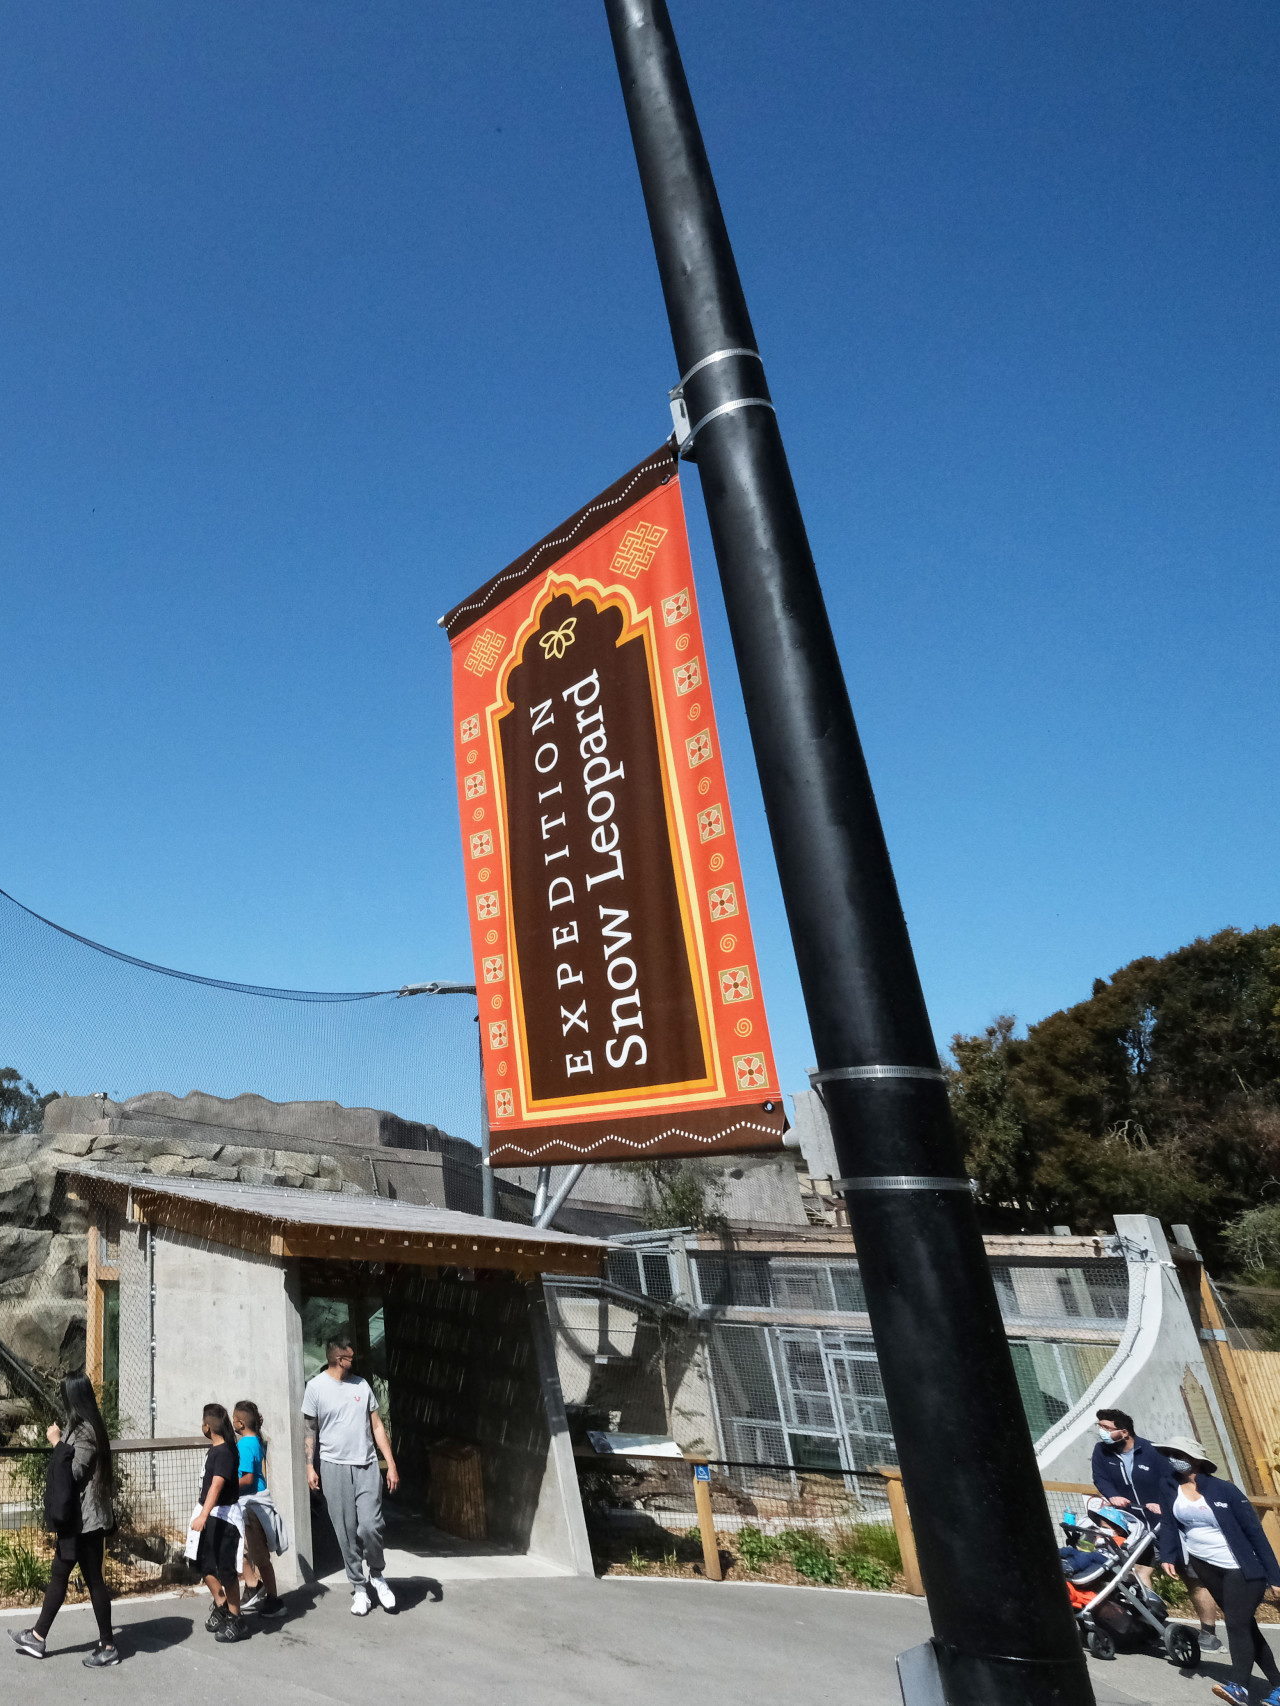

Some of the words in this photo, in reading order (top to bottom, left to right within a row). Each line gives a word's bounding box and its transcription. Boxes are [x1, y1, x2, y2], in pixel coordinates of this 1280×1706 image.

[529, 698, 594, 1078] EXPEDITION
[562, 668, 625, 891] Leopard
[598, 904, 648, 1069] Snow
